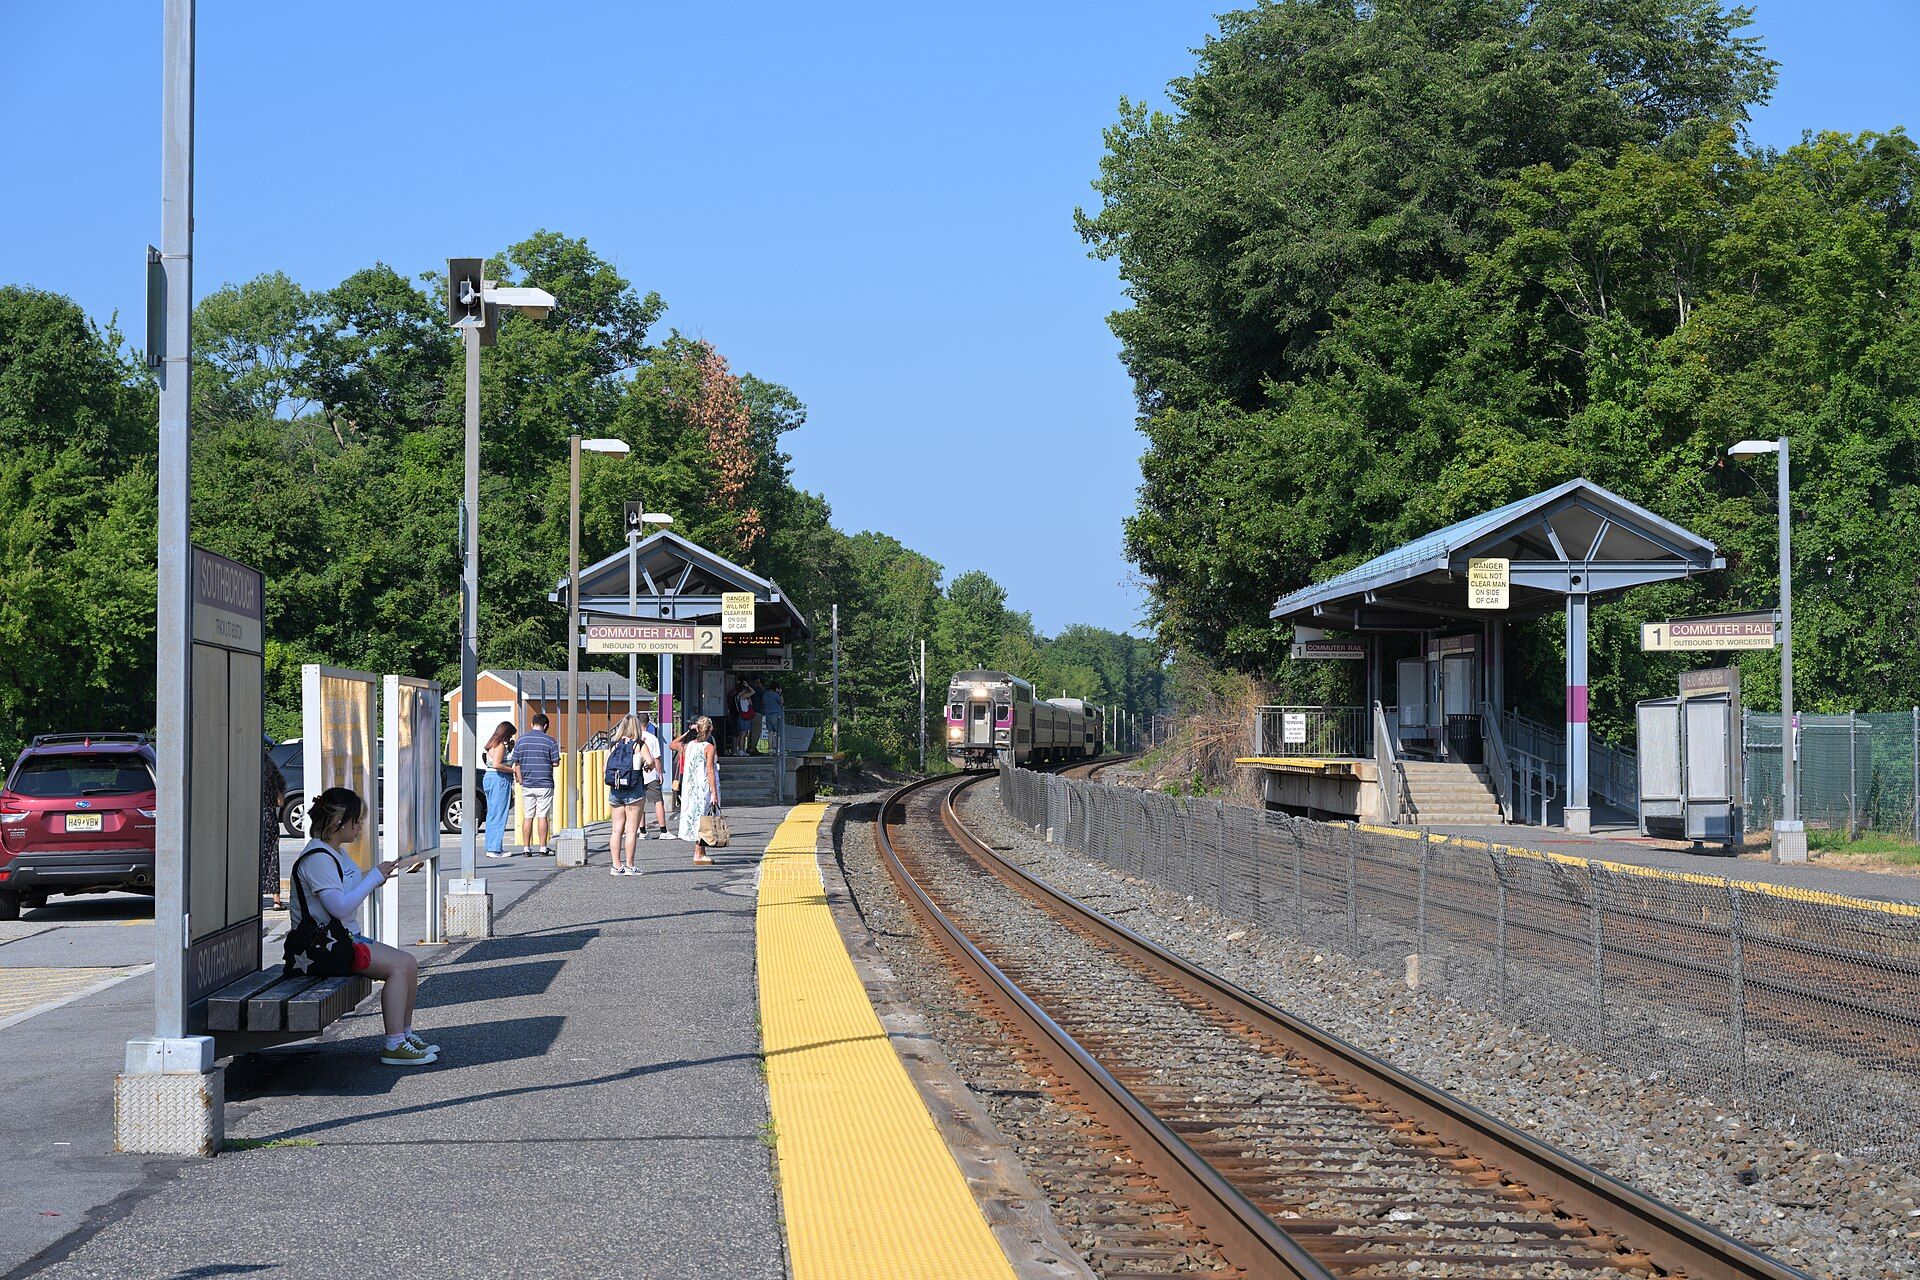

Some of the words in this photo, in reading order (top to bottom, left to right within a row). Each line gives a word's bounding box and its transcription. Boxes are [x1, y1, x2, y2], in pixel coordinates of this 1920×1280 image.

[201, 558, 254, 610] SOUTHBOROUGH
[589, 627, 659, 638] COMMUTER
[664, 628, 692, 638] RAIL
[1672, 624, 1740, 635] COMMUTER
[1745, 624, 1772, 634] RAIL
[700, 630, 714, 649] 2
[1652, 628, 1661, 646] 1
[1297, 646, 1302, 656] 1
[783, 660, 790, 669] 2
